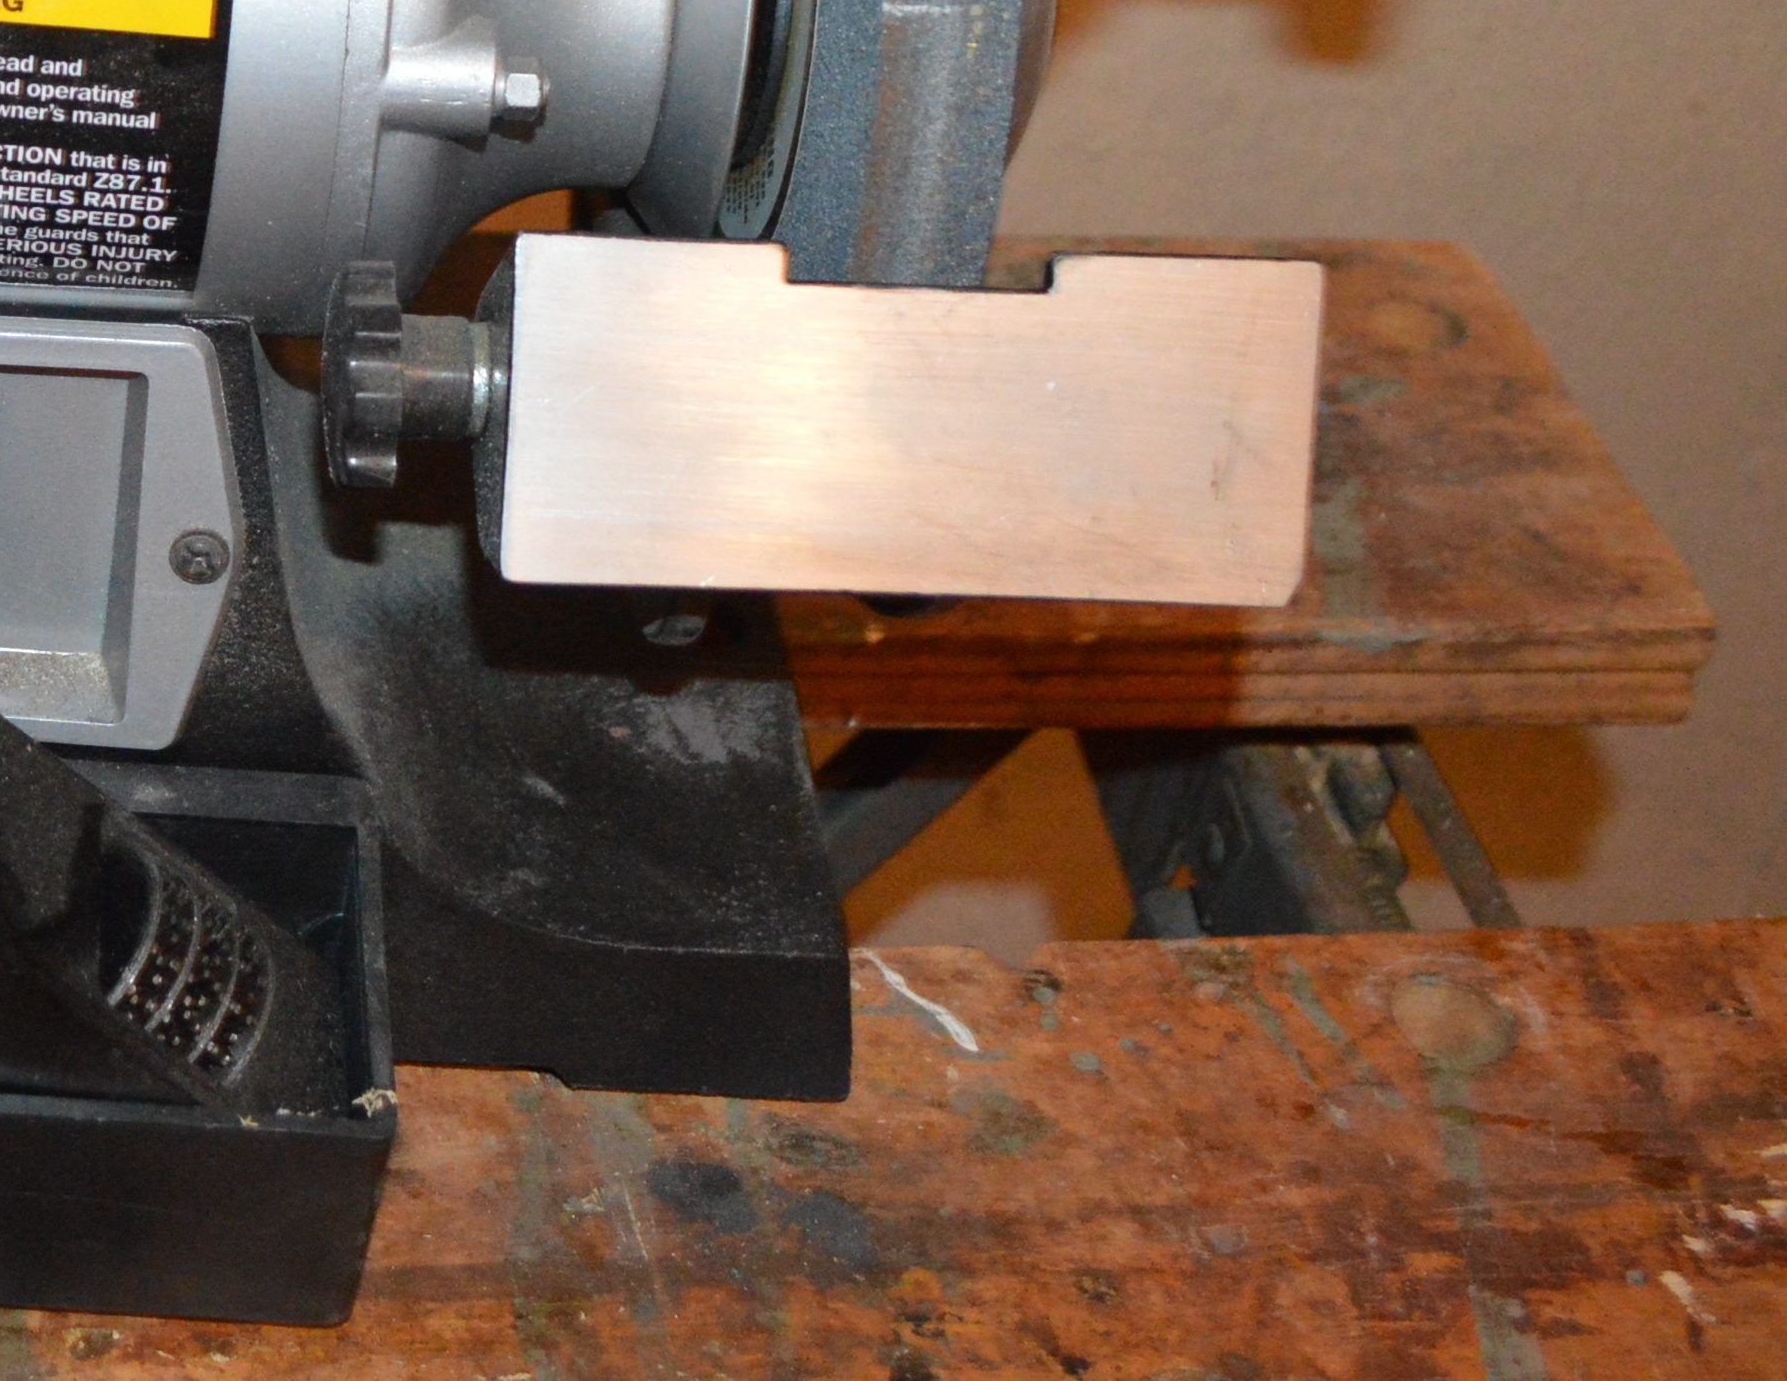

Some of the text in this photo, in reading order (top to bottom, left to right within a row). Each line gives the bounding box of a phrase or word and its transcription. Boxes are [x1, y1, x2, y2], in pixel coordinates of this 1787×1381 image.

[40, 59, 84, 76] and
[26, 81, 136, 108] operating
[71, 109, 157, 129] manual
[70, 151, 115, 169] that
[121, 155, 141, 172] is
[147, 156, 168, 173] in
[93, 172, 171, 194] Z87.1.
[83, 191, 164, 212] RATED
[54, 208, 135, 228] SPEED
[142, 215, 177, 231] OF
[24, 225, 99, 242] guards
[105, 230, 150, 245] that
[91, 244, 177, 262] INJURY
[52, 257, 87, 270] DO
[97, 259, 146, 273] NOT
[56, 271, 79, 281] of
[85, 273, 178, 288] children.
